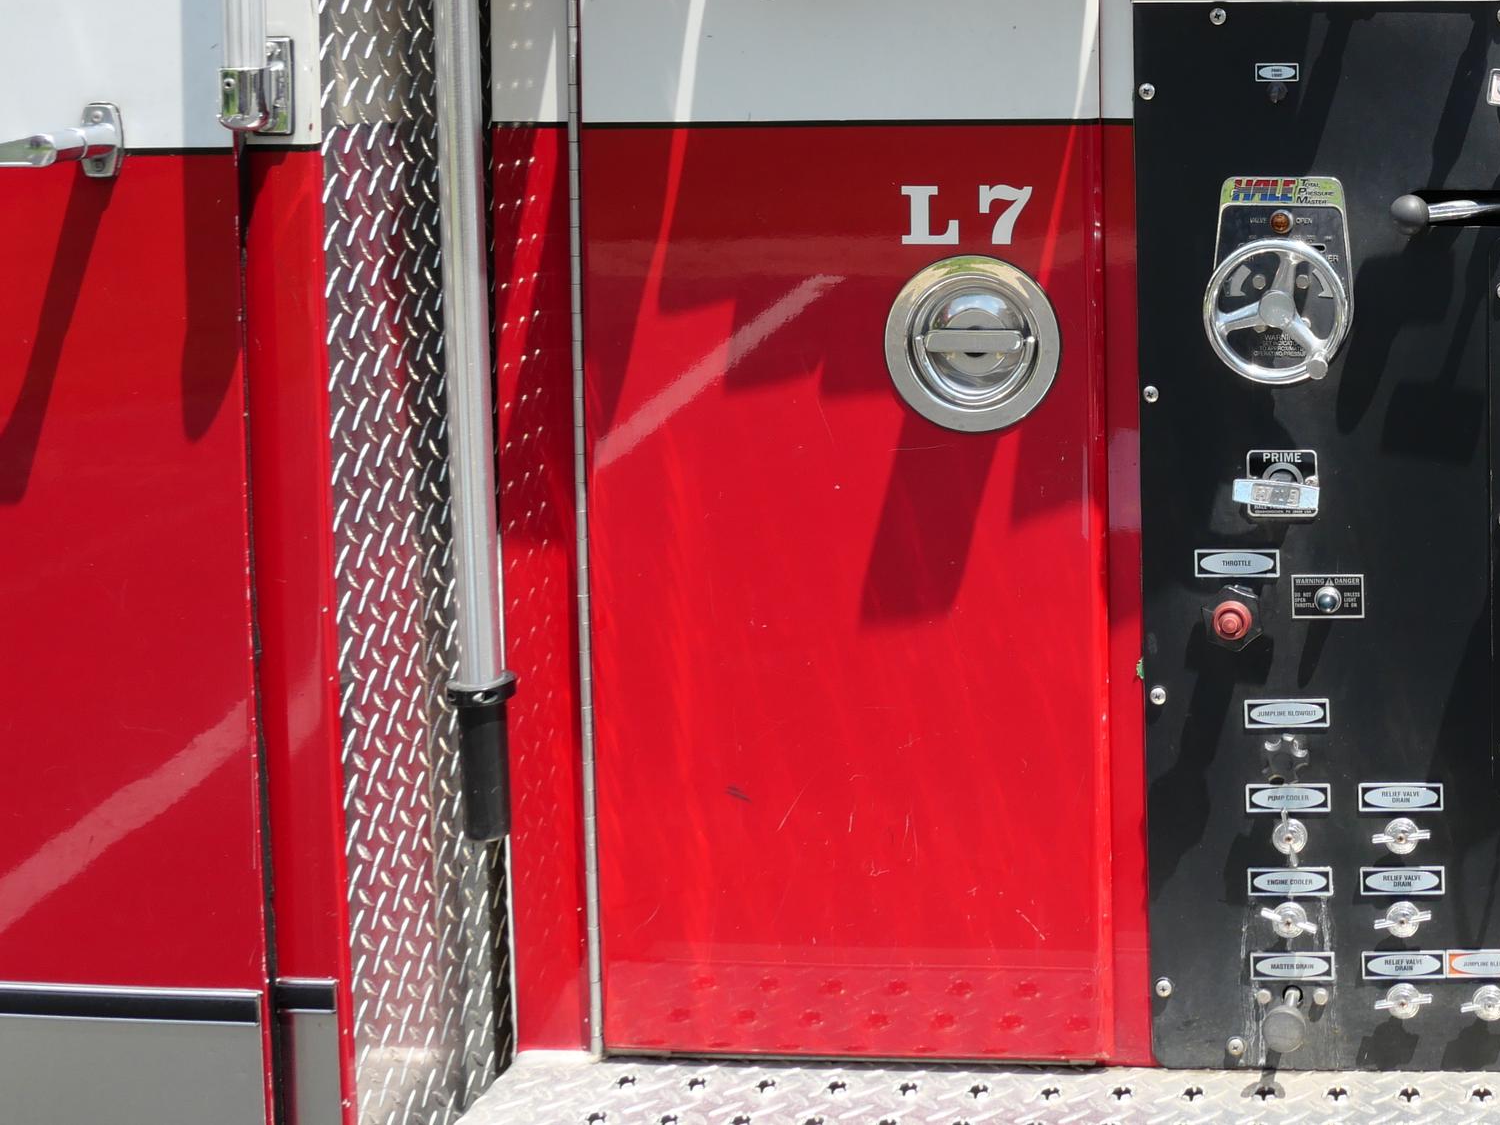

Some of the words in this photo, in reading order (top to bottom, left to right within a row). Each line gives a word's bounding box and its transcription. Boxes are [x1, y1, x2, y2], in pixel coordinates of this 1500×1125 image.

[1231, 179, 1296, 202] HALE
[901, 185, 959, 245] L
[979, 185, 1032, 245] 7
[1263, 453, 1302, 463] PRIME
[1288, 709, 1317, 717] BLOWOUT
[1393, 880, 1412, 888] DRAIN
